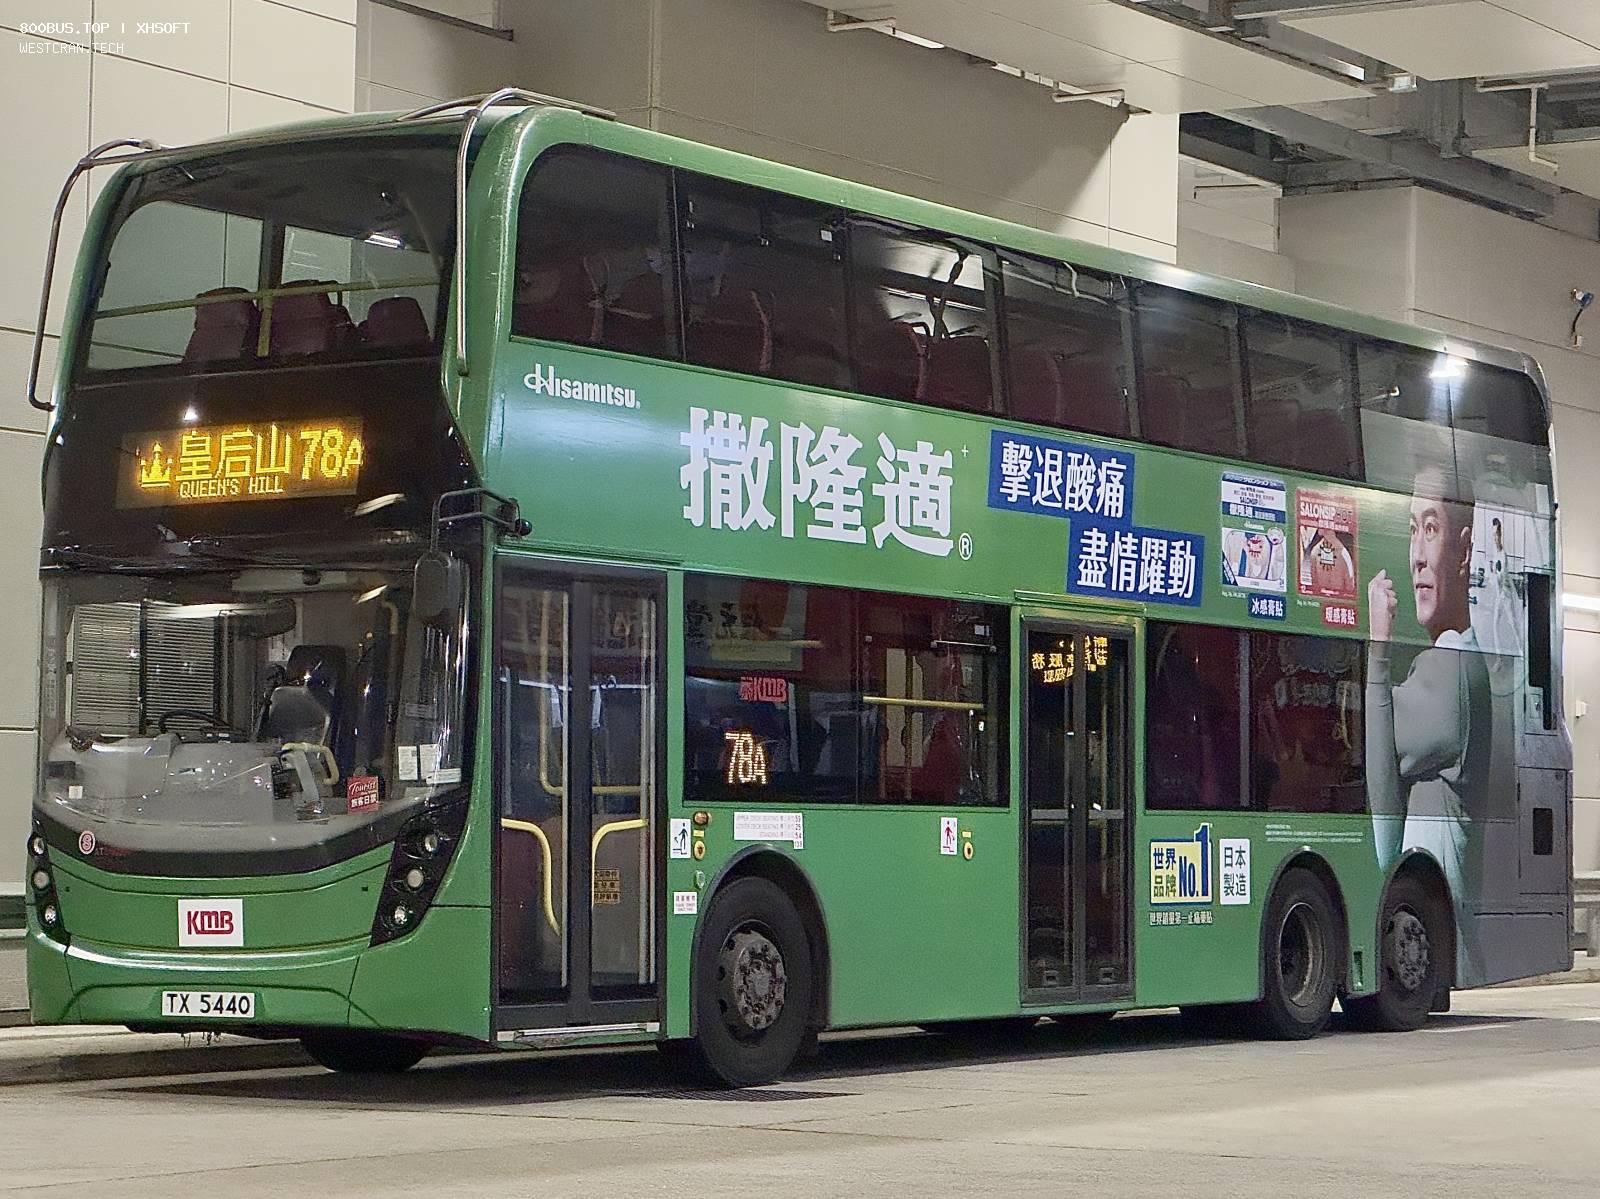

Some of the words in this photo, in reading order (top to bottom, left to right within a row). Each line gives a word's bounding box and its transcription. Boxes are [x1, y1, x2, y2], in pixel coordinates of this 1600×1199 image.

[175, 423, 293, 481] 皇后山
[300, 428, 364, 480] 78A
[179, 478, 241, 498] QUEEN'S
[248, 475, 283, 495] HILL
[999, 440, 1127, 518] 擊退酸痛
[1300, 501, 1336, 520] SALONSIP
[1076, 527, 1196, 599] 盡情躍動
[1251, 597, 1284, 617] 冰感膏貼
[753, 676, 787, 702] KMB
[724, 731, 767, 785] 78A
[1153, 848, 1177, 870] 世界
[1224, 846, 1246, 869] 日本
[1153, 875, 1177, 898] 品牌
[1223, 874, 1246, 897] 製造
[187, 911, 234, 935] KMB
[166, 993, 190, 1014] TX
[200, 994, 250, 1015] 5440
